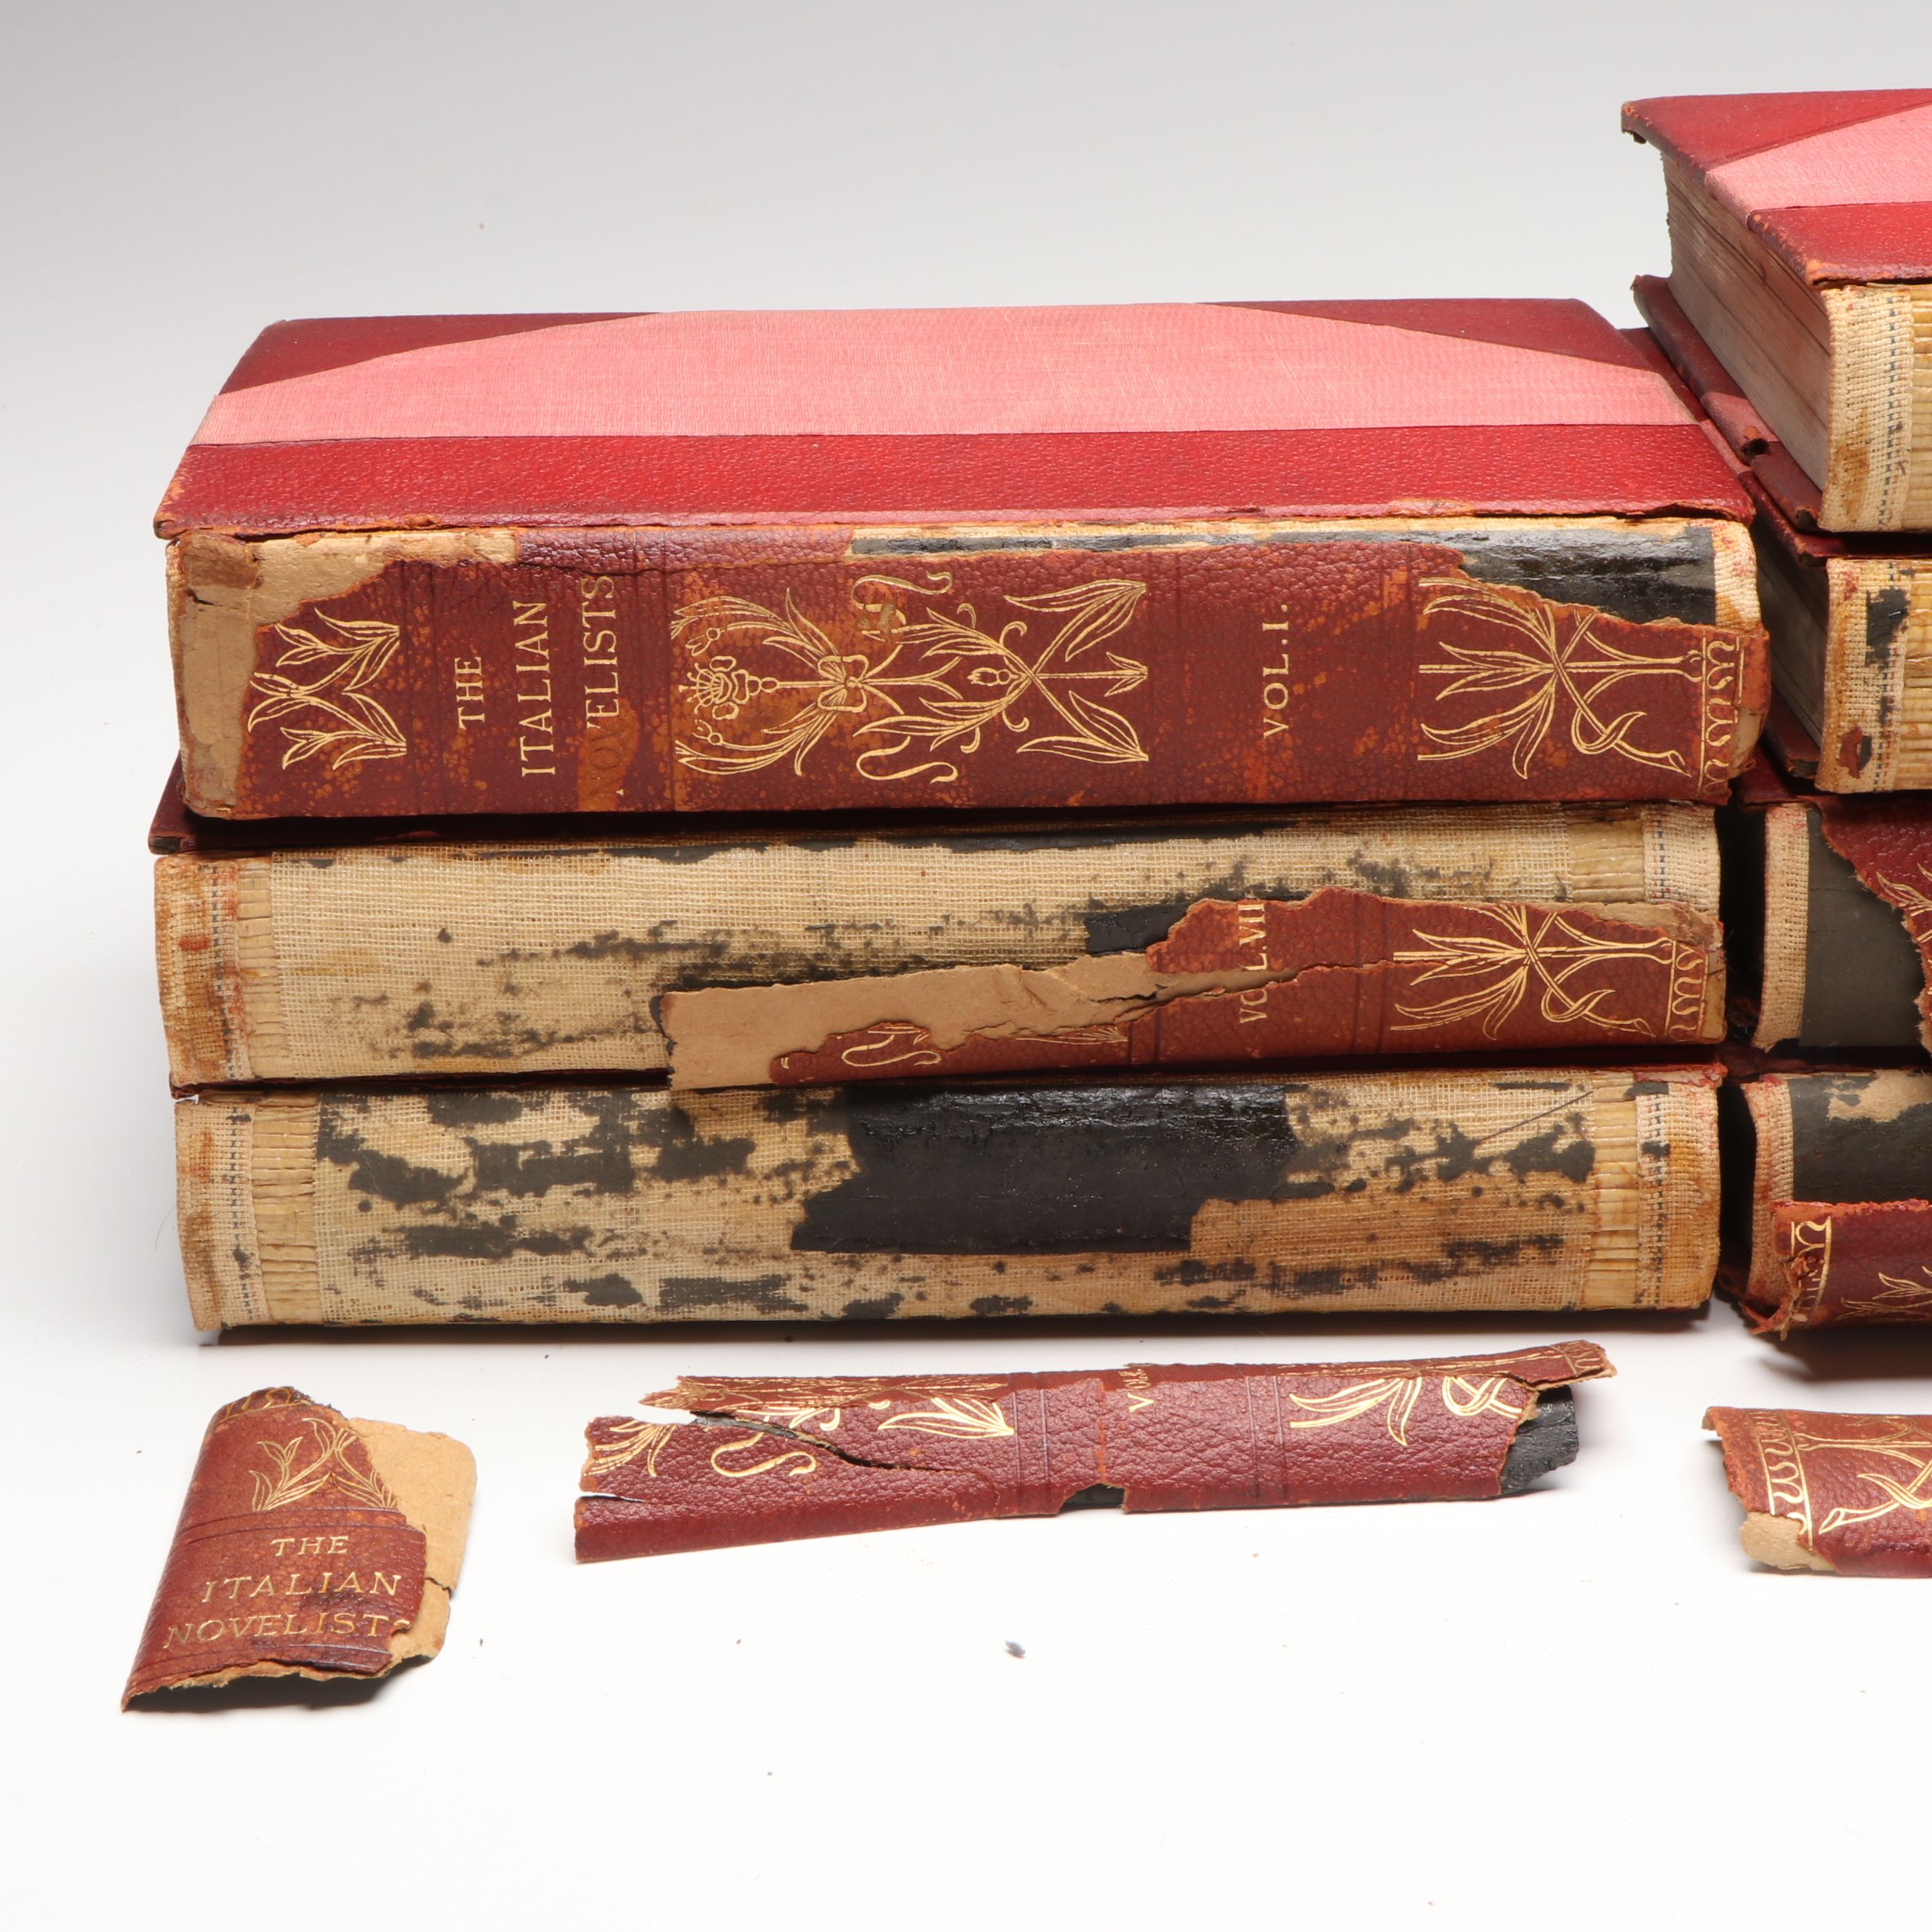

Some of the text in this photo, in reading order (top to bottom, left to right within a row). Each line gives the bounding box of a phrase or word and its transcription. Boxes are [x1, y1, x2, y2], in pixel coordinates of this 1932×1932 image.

[454, 656, 486, 730] THE
[512, 600, 556, 778] ITALIAN
[271, 1536, 350, 1557] THE
[201, 1572, 402, 1604] ITALIAN
